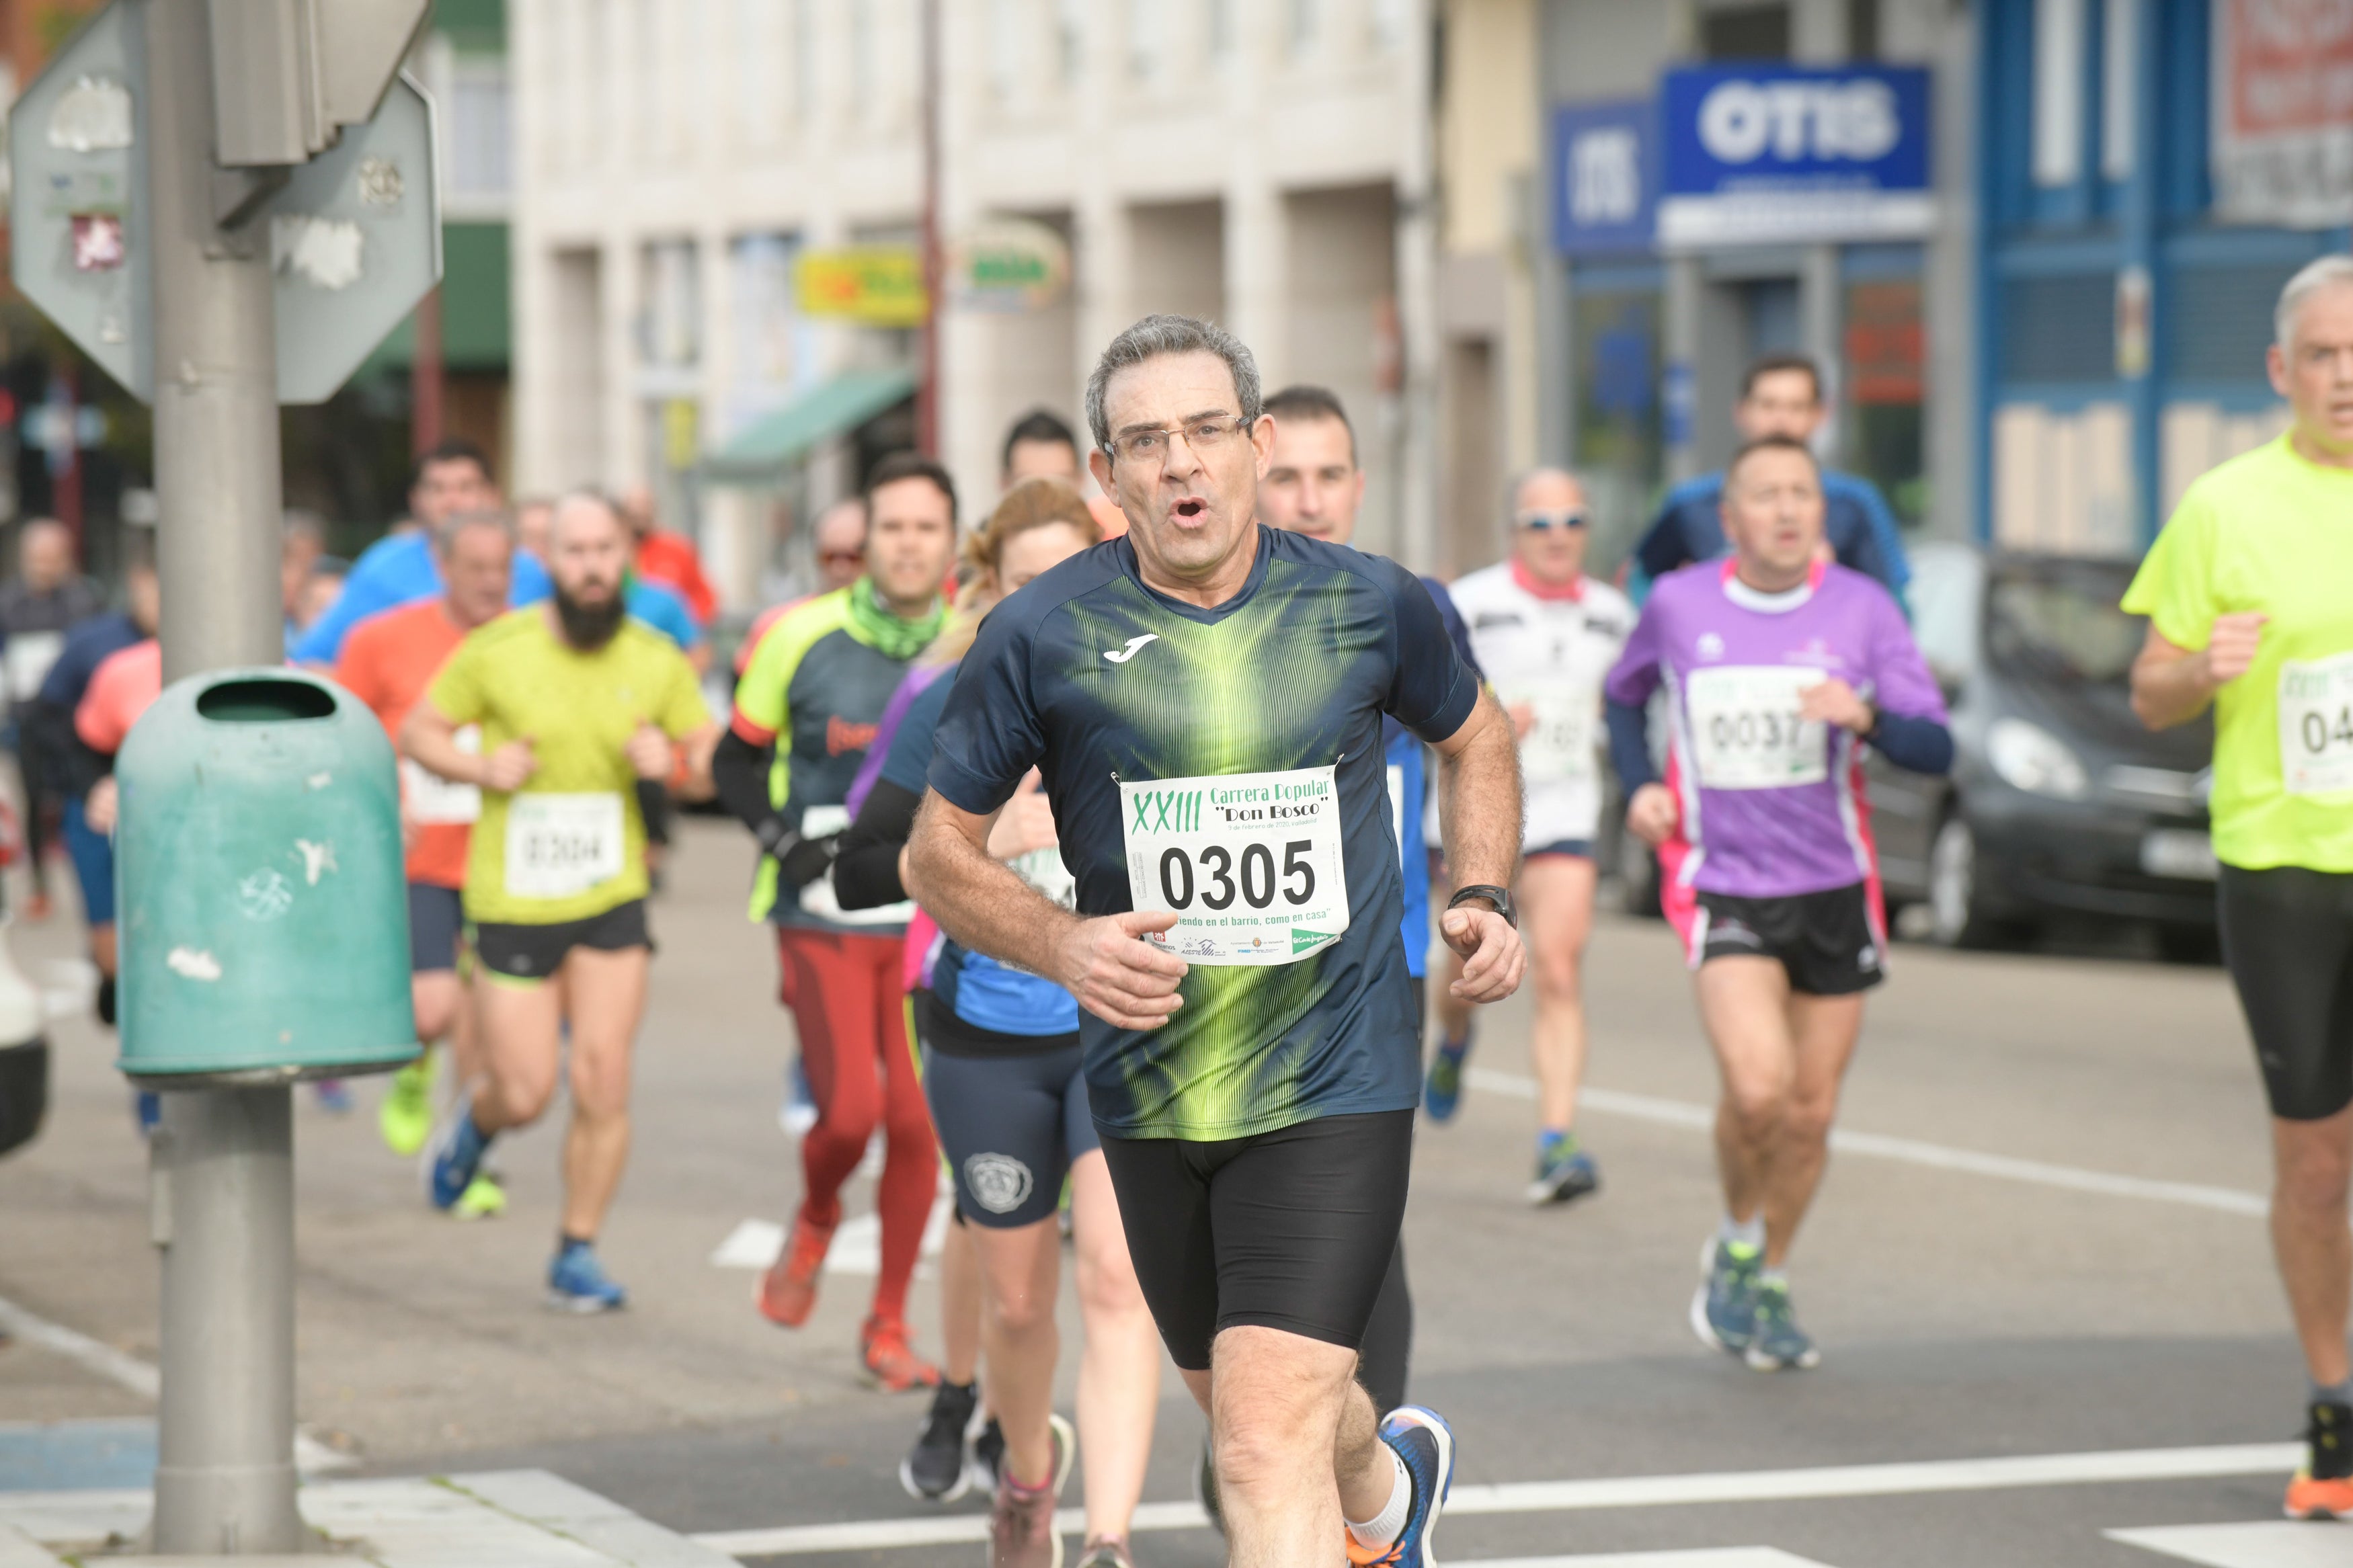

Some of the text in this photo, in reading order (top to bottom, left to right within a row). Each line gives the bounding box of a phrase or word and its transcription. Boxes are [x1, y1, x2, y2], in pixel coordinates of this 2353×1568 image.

[1698, 78, 1900, 163] OTIS
[1711, 711, 1801, 750] 0037
[1132, 790, 1202, 835] XXIII
[1210, 780, 1329, 804] Carrera Popular
[1160, 839, 1315, 910] 0305
[1176, 916, 1203, 926] iendo
[1206, 918, 1217, 926] en
[1220, 917, 1228, 926] el
[1232, 916, 1262, 926] barrio,
[1265, 915, 1289, 925] como
[1293, 914, 1302, 922] en
